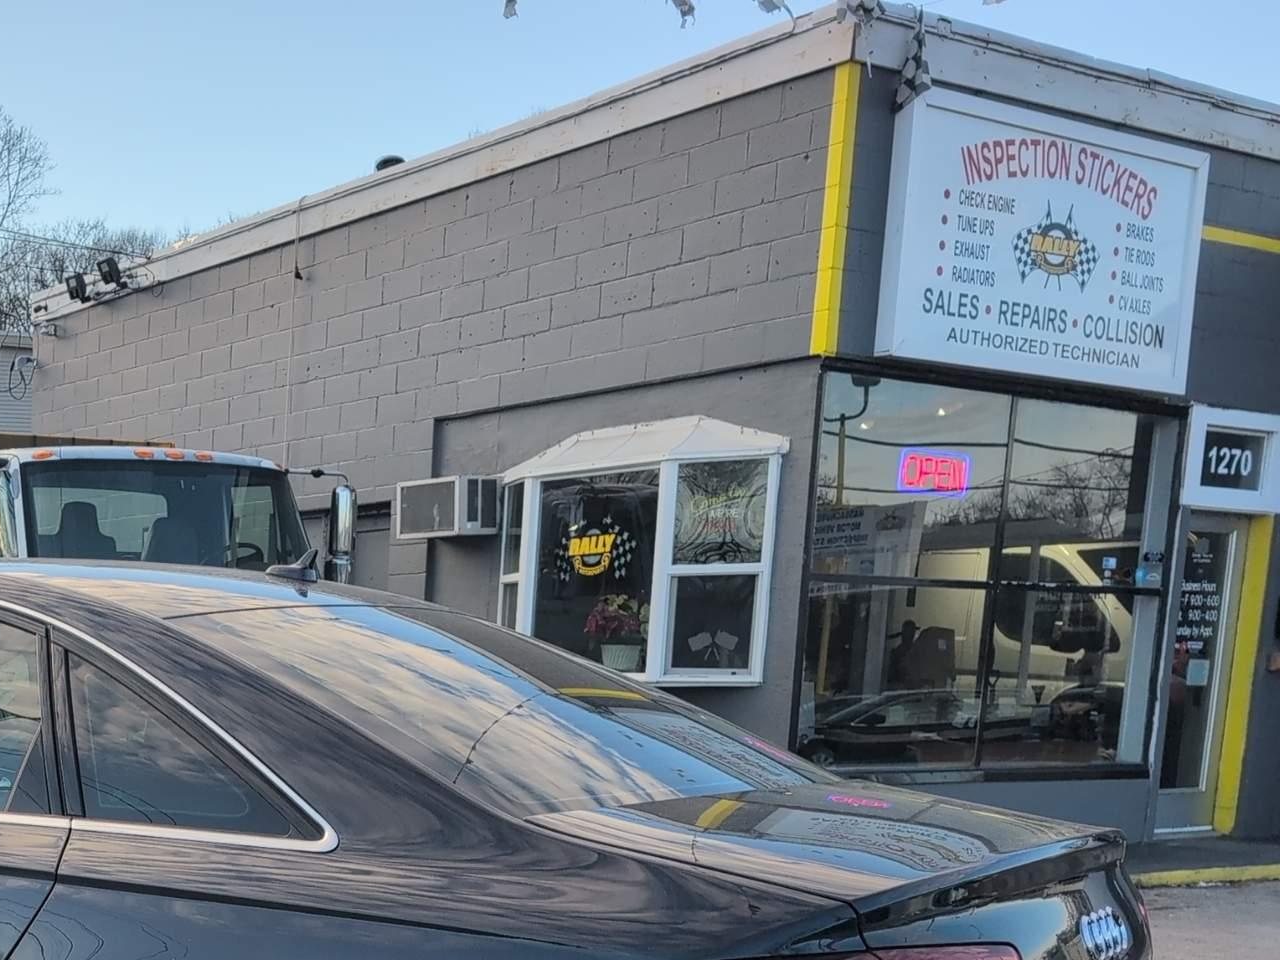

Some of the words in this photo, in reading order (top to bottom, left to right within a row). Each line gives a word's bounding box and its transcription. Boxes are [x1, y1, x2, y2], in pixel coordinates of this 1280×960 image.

[961, 138, 1072, 185] INSPECTION
[1075, 147, 1158, 220] STICKERS
[959, 189, 986, 209] CHECK
[987, 194, 1016, 215] ENGINE
[957, 214, 978, 233] TUNE
[979, 219, 995, 236] UPS
[1126, 222, 1154, 242] BRAKES
[953, 240, 990, 262] EXHAUST
[1030, 233, 1080, 257] RALLY
[1124, 246, 1135, 263] TIE
[1136, 248, 1155, 267] RODS
[951, 265, 996, 288] RADIATORS
[1120, 270, 1138, 288] BALL
[1139, 274, 1164, 293] JOINTS
[1118, 295, 1129, 311] CV
[1128, 296, 1151, 315] AXLES
[922, 287, 980, 321] SALES
[997, 299, 1068, 334] REPAIRS
[1082, 314, 1166, 350] COLLISION
[946, 326, 1050, 357] AUTHORIZED
[1051, 342, 1141, 370] TECHNICIAN
[1208, 446, 1253, 476] 1270
[903, 455, 966, 491] OPEN
[568, 533, 617, 556] RALLY
